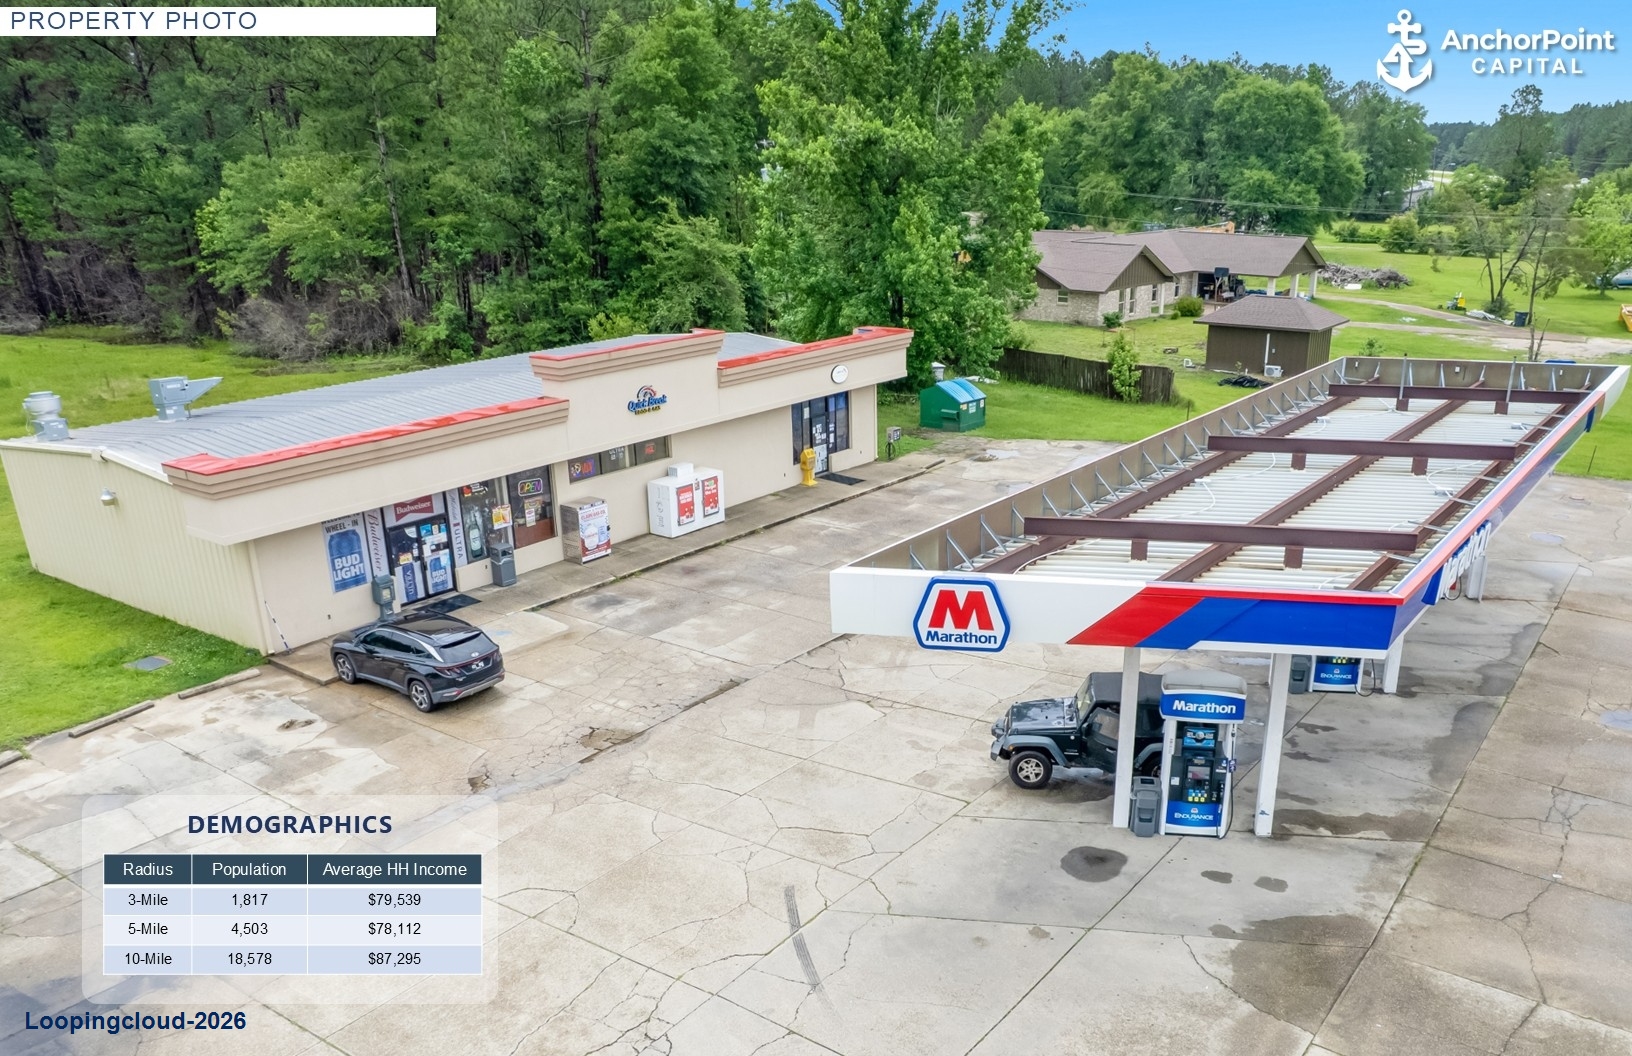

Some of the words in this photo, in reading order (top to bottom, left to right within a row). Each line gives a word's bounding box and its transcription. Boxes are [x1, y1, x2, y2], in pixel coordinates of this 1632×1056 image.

[628, 398, 647, 412] Quick
[519, 480, 542, 494] OPEN
[395, 500, 432, 515] Budweiser
[325, 523, 346, 534] WHEEL
[352, 519, 359, 527] IN
[367, 511, 383, 572] Budweiser
[454, 528, 465, 559] ULTRA
[334, 554, 360, 570] BUD
[333, 563, 365, 582] LIGHT
[928, 589, 994, 630] M
[926, 630, 998, 645] Marathon
[1172, 699, 1237, 714] Marathon
[1174, 812, 1214, 821] ENDURANCE
